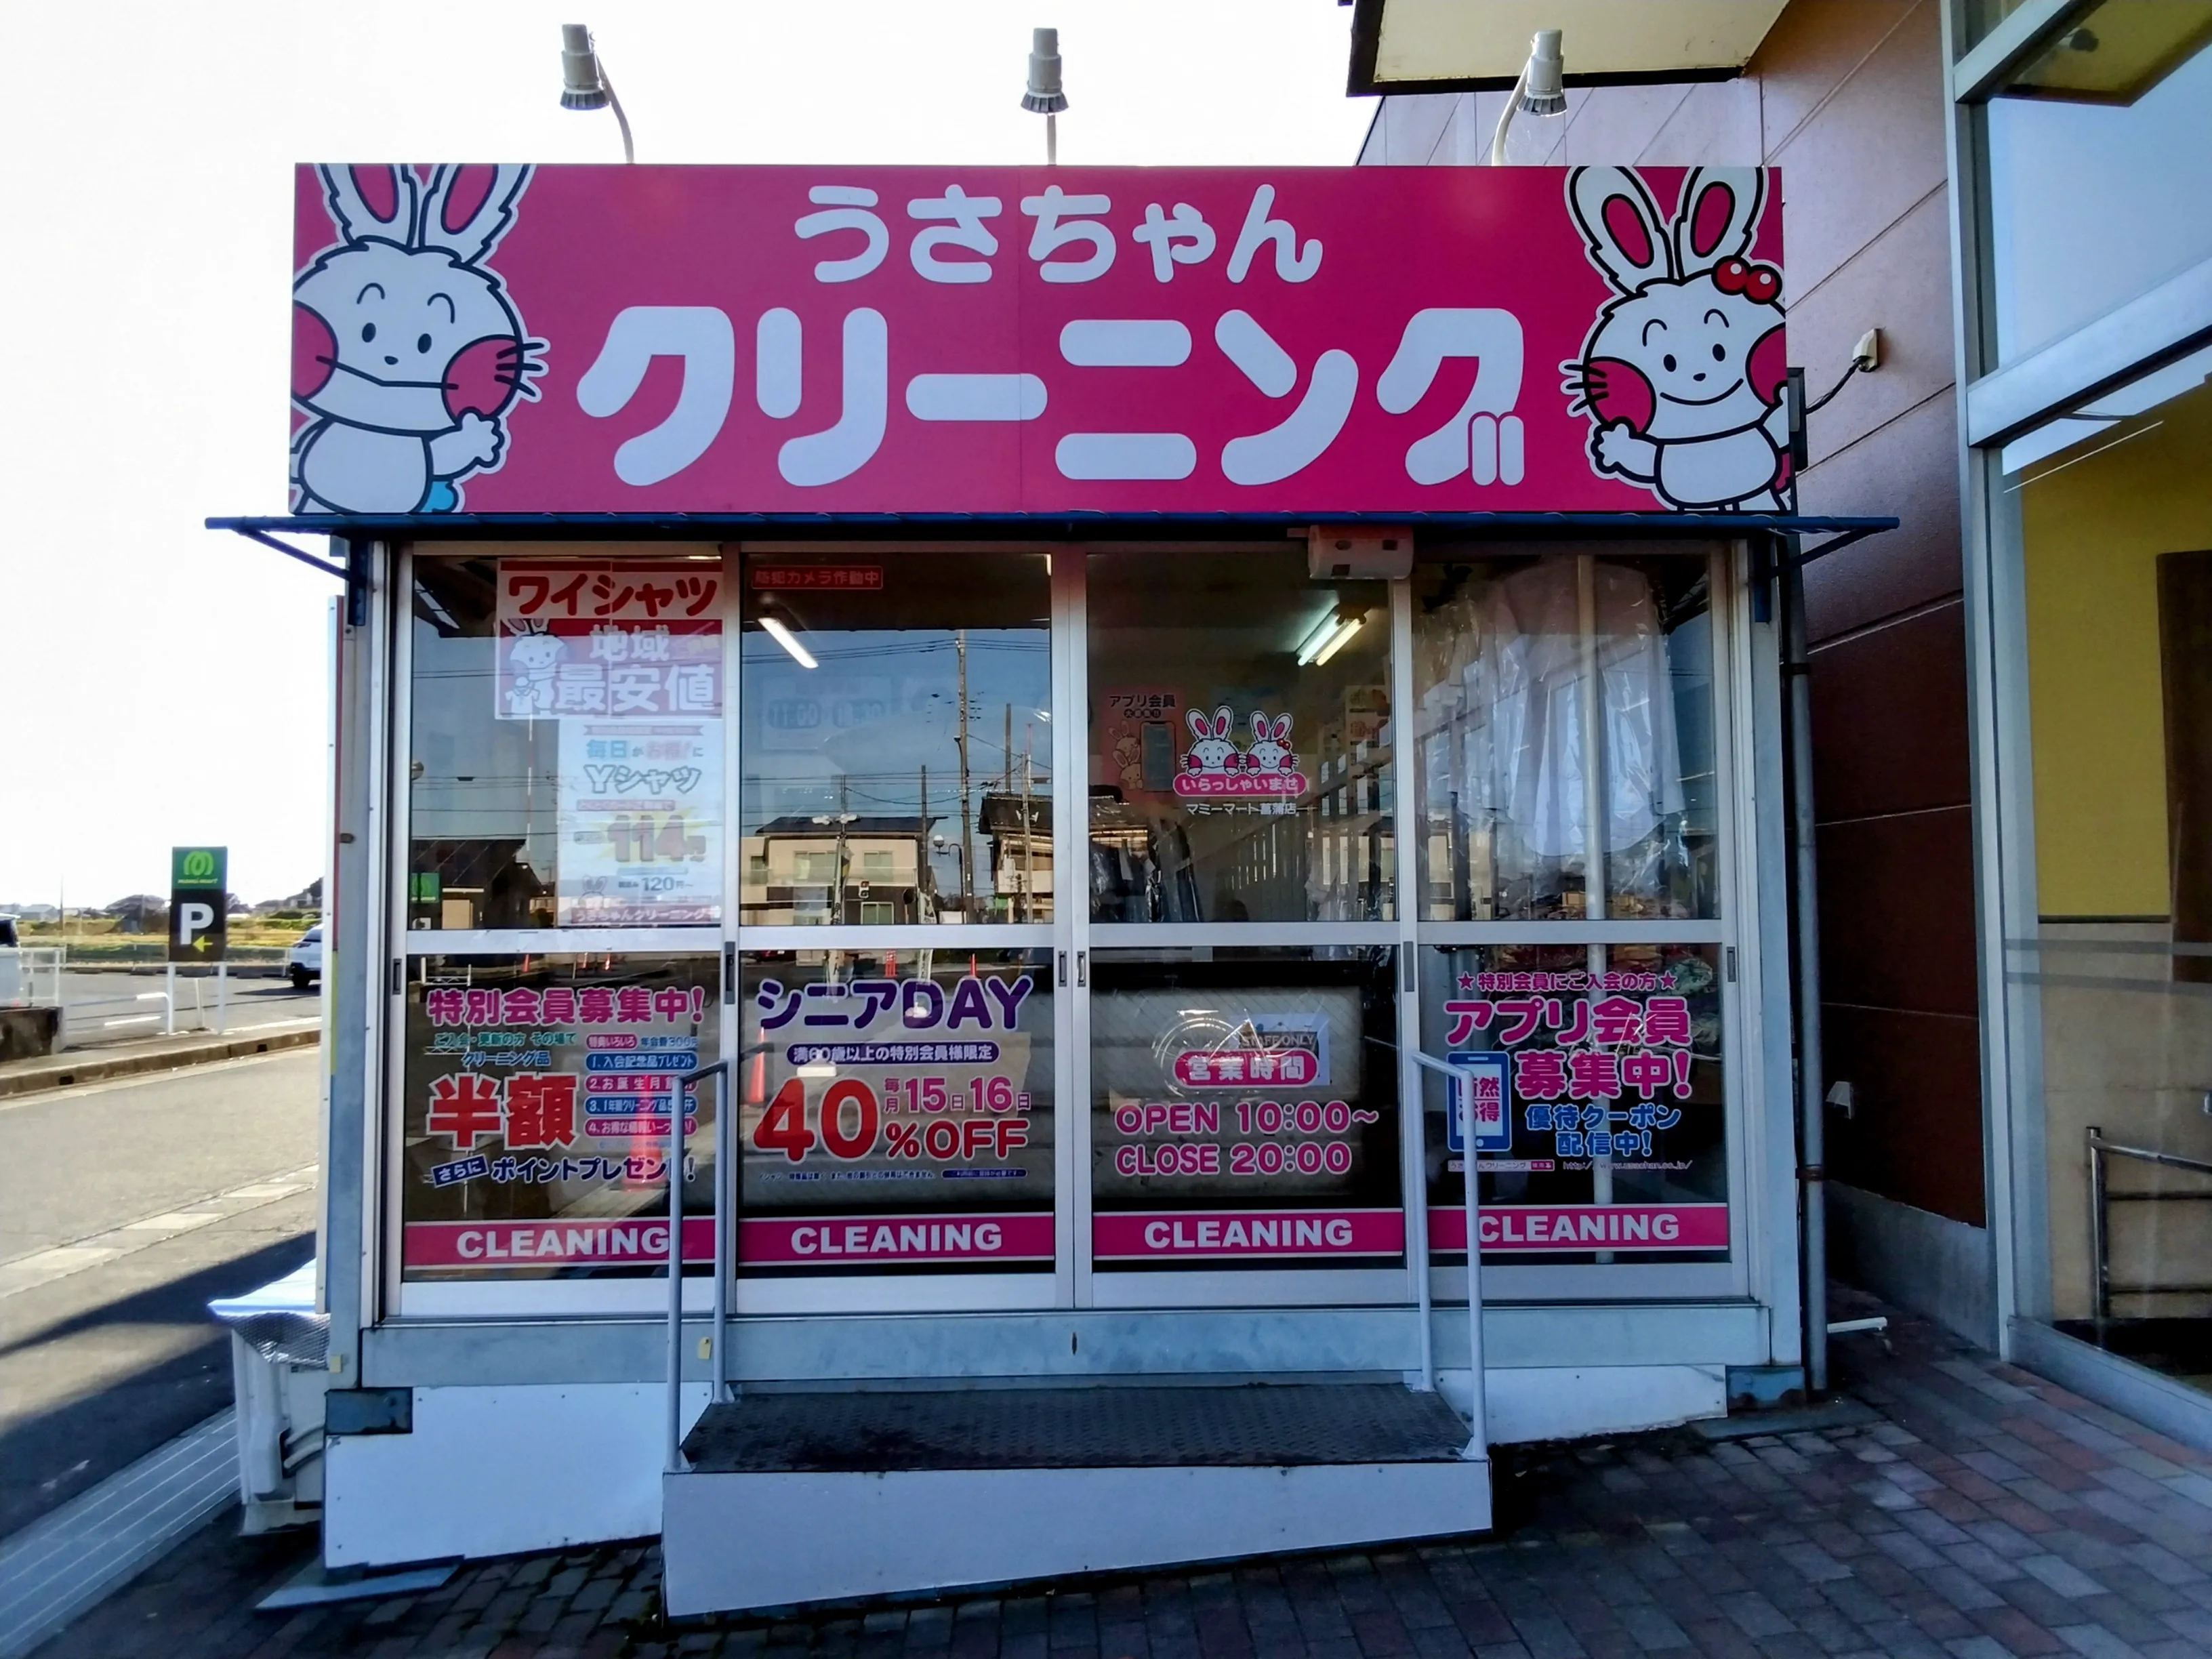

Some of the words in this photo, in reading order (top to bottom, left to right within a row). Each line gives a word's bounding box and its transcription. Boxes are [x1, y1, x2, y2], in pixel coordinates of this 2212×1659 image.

[794, 184, 1323, 283] うさちゃん
[576, 305, 1525, 487] クリーニング
[755, 570, 880, 586] 防犯カメラ作動中
[508, 573, 718, 617] ワイシャツ
[589, 624, 670, 661] 地域
[555, 663, 716, 712] 最安値
[1109, 695, 1176, 708] アプリ会員
[583, 764, 702, 795] Yシャツ
[1181, 777, 1298, 792] いらっしゃいませ
[180, 903, 213, 945] P
[1477, 972, 1658, 992] 特別会員にご入会の方
[426, 986, 705, 1026] 特別会員募集中!
[757, 975, 1033, 1032] シニアDAY
[1443, 995, 1692, 1047] アプリ会員
[793, 1044, 993, 1063] 満60歳以上の特別会員様限定
[1282, 1034, 1314, 1045] ONLY
[462, 1050, 551, 1067] クリーニング品
[1187, 1055, 1305, 1080] 営業時間
[1515, 1048, 1693, 1100] 募集中!
[426, 1071, 579, 1151] 半額
[1115, 1102, 1219, 1135] OPEN
[1525, 1103, 1681, 1131] 優待クーポン
[1115, 1143, 1219, 1177] CLOSE
[1231, 1141, 1352, 1174] 20:00
[1556, 1130, 1652, 1157] 配信中!
[438, 1160, 483, 1180] さらに
[491, 1156, 697, 1183] ポイントプレゼン!
[456, 1227, 669, 1258] CLEANING
[791, 1223, 1002, 1254] CLEANING
[1144, 1219, 1353, 1248] CLEANING
[1479, 1214, 1679, 1242] CLEANING
